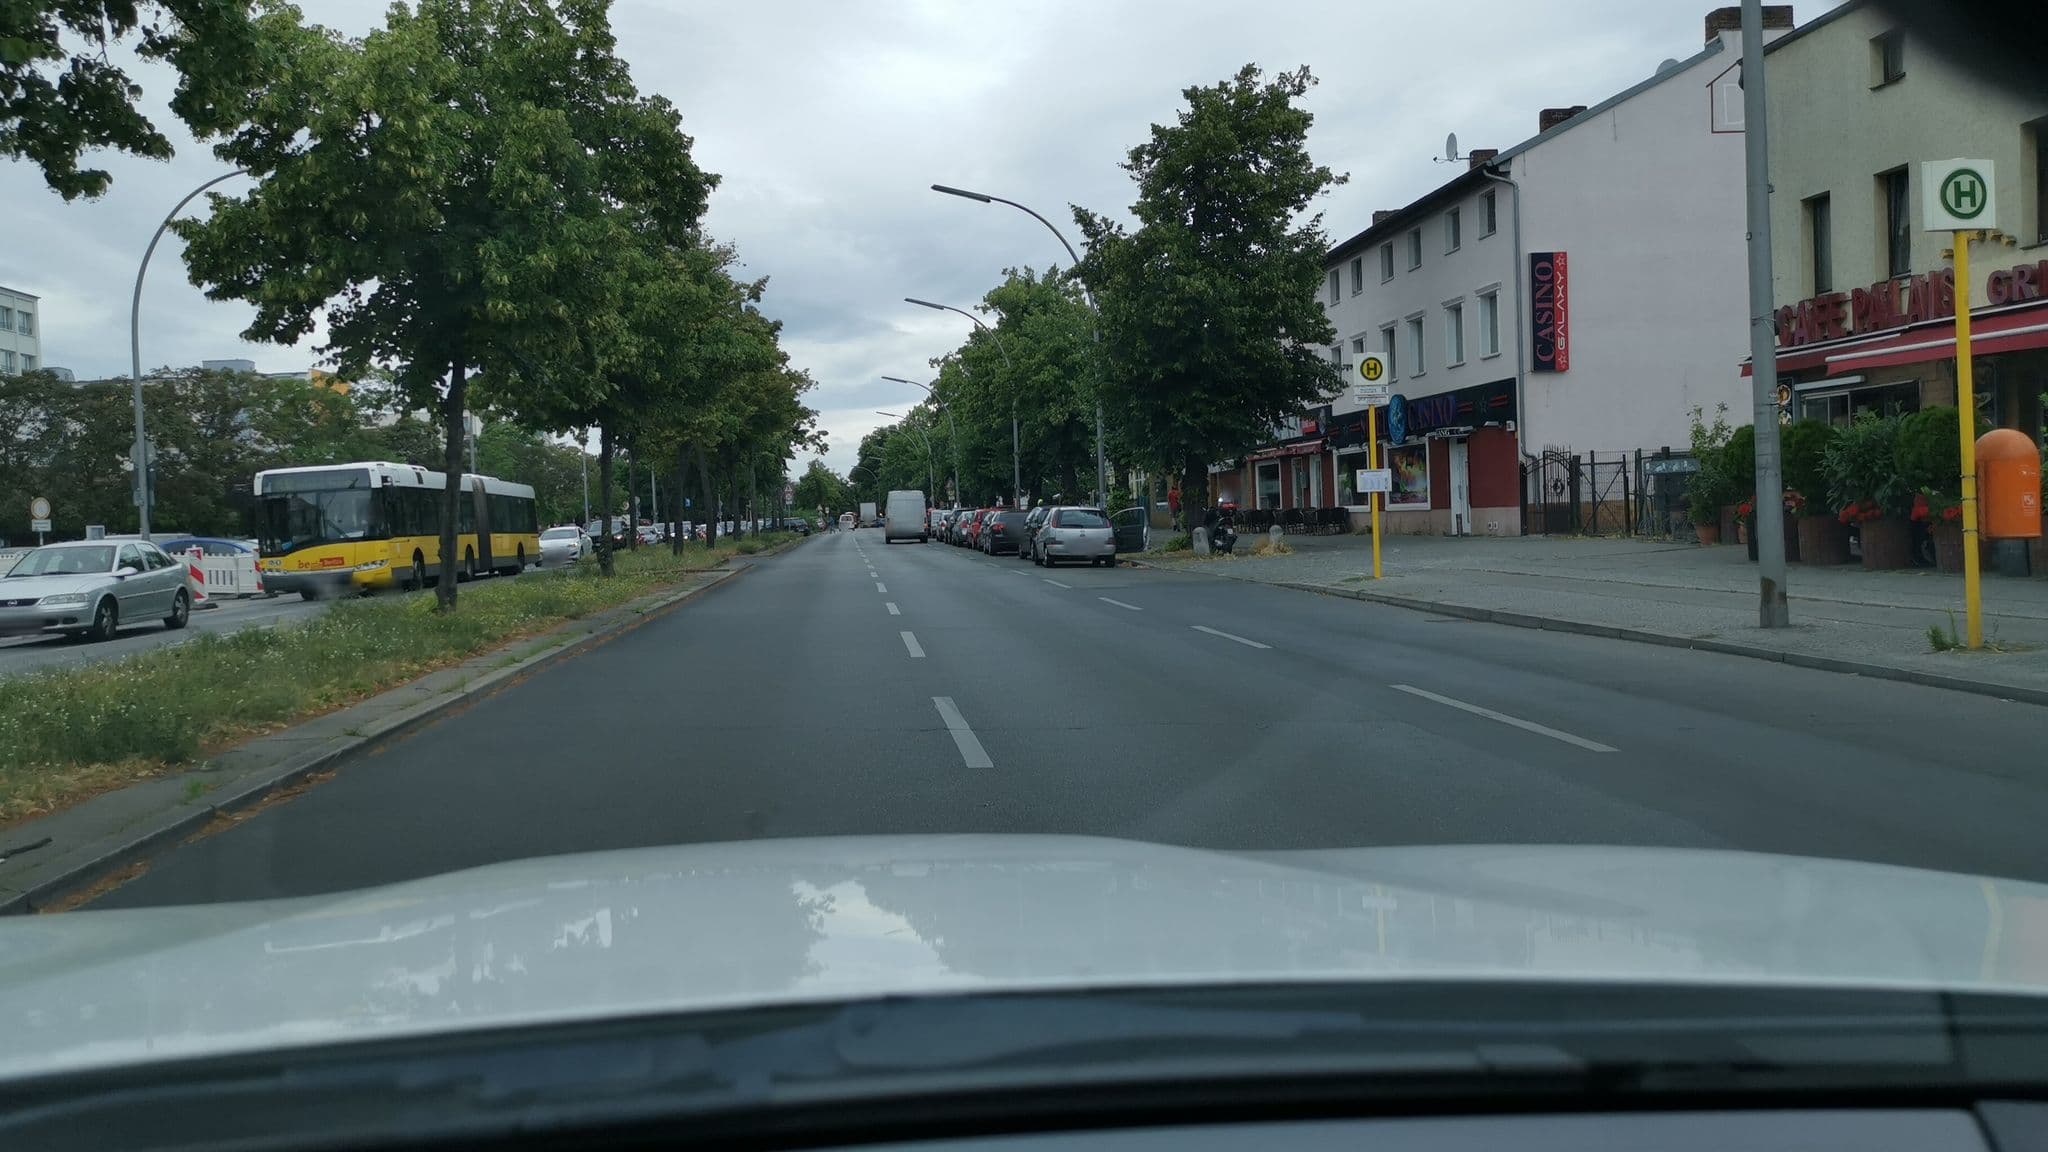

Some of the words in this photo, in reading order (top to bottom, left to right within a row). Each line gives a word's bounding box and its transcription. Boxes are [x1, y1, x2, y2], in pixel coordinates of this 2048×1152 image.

[1954, 180, 1977, 209] H
[1535, 260, 1555, 362] CASINO
[1556, 271, 1567, 351] GALAXY
[1852, 267, 1955, 333] PALAIS
[1366, 362, 1378, 376] H
